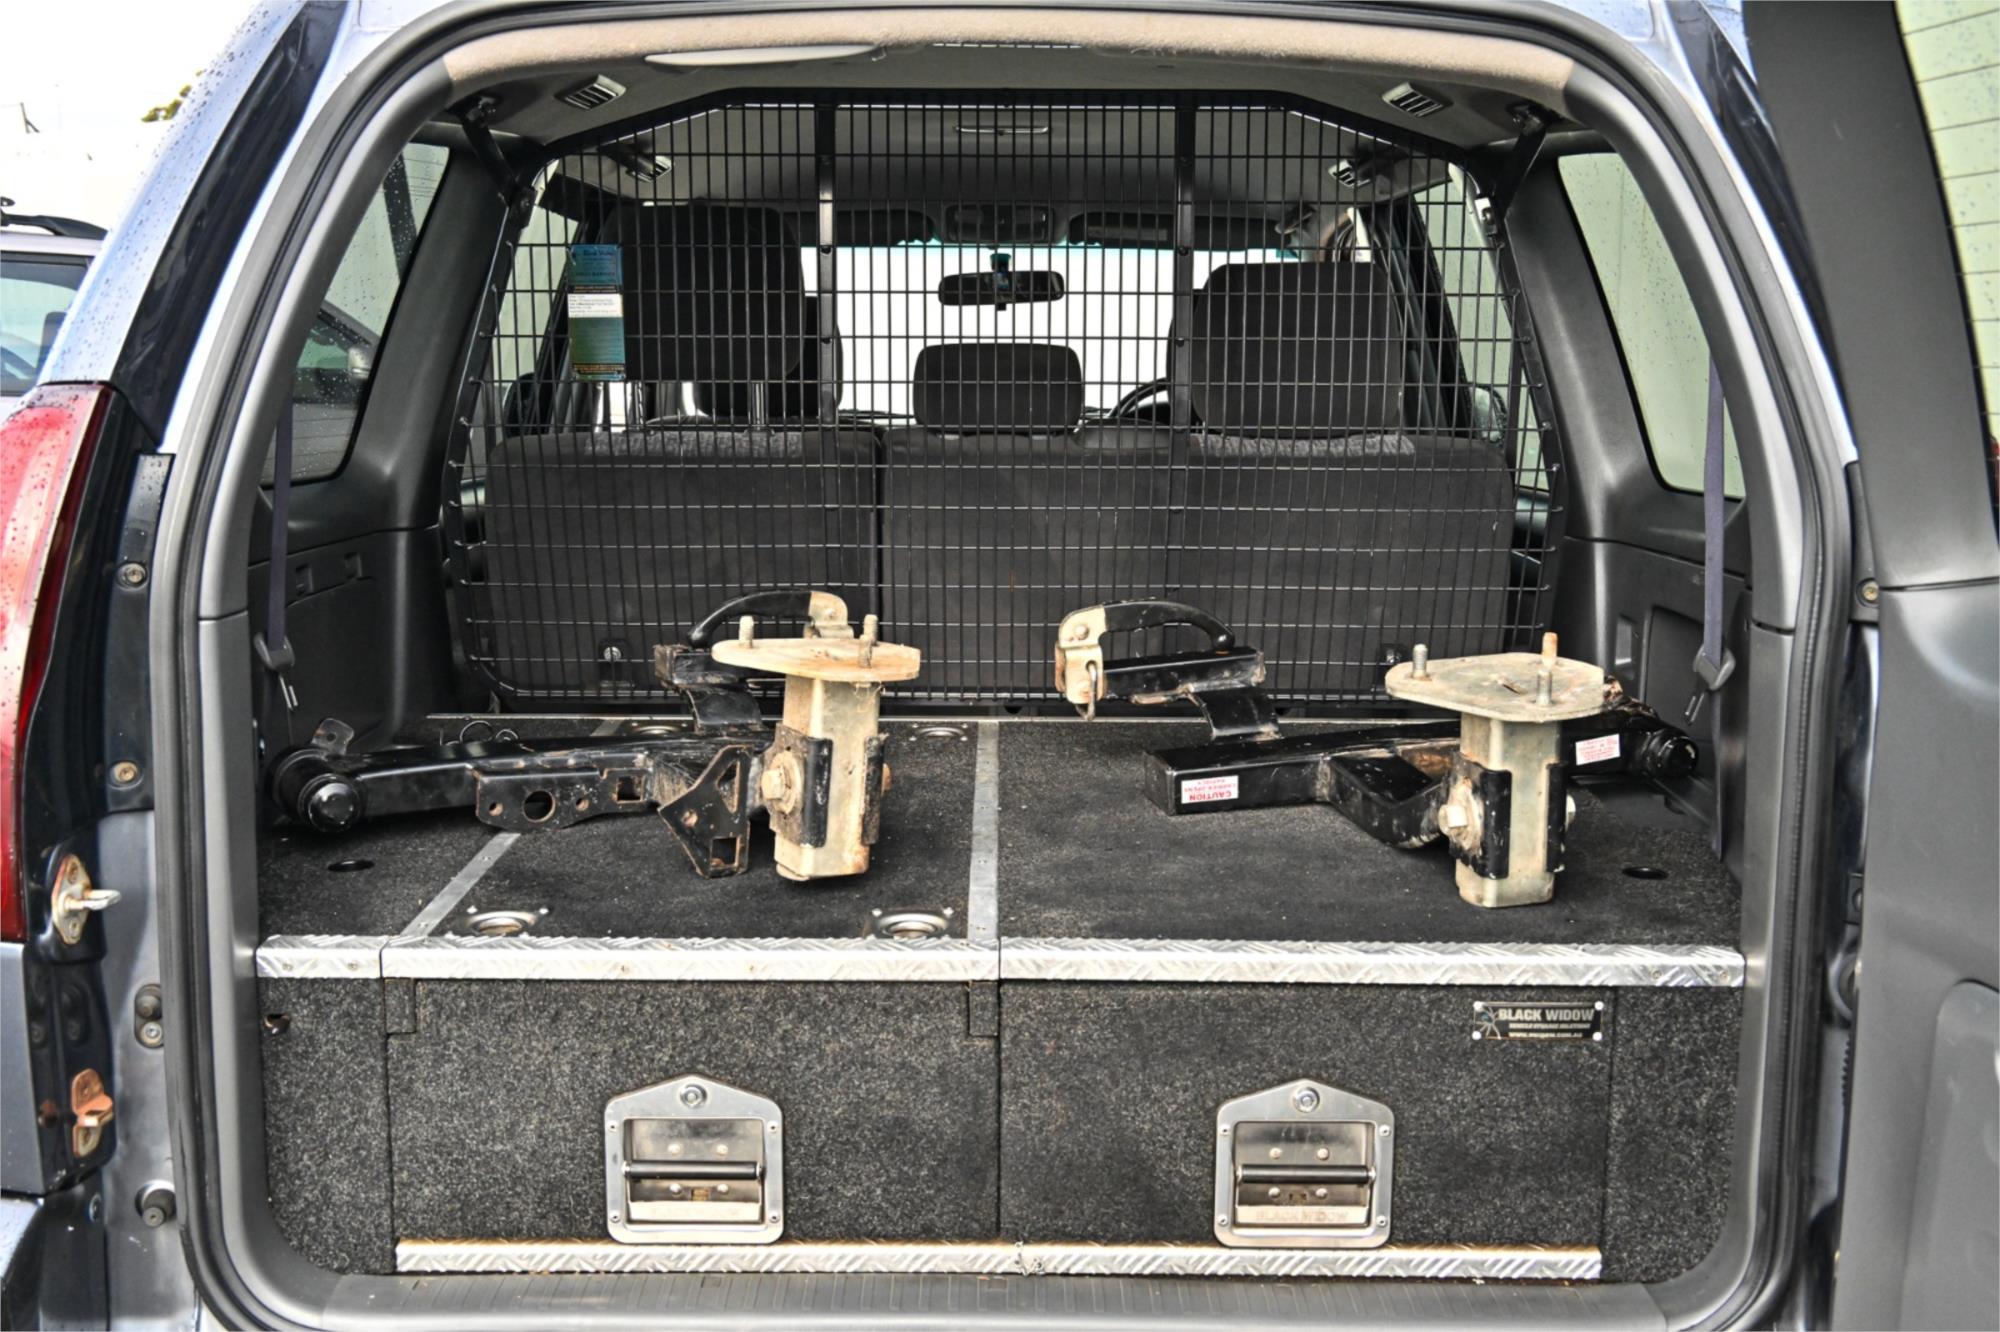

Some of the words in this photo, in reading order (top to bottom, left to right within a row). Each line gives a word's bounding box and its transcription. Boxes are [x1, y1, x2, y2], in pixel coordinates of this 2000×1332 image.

[1189, 790, 1232, 801] CAUTION
[1498, 1008, 1542, 1021] BLACK
[1545, 1008, 1594, 1021] WIDOW
[1302, 1210, 1349, 1222] WIDOW
